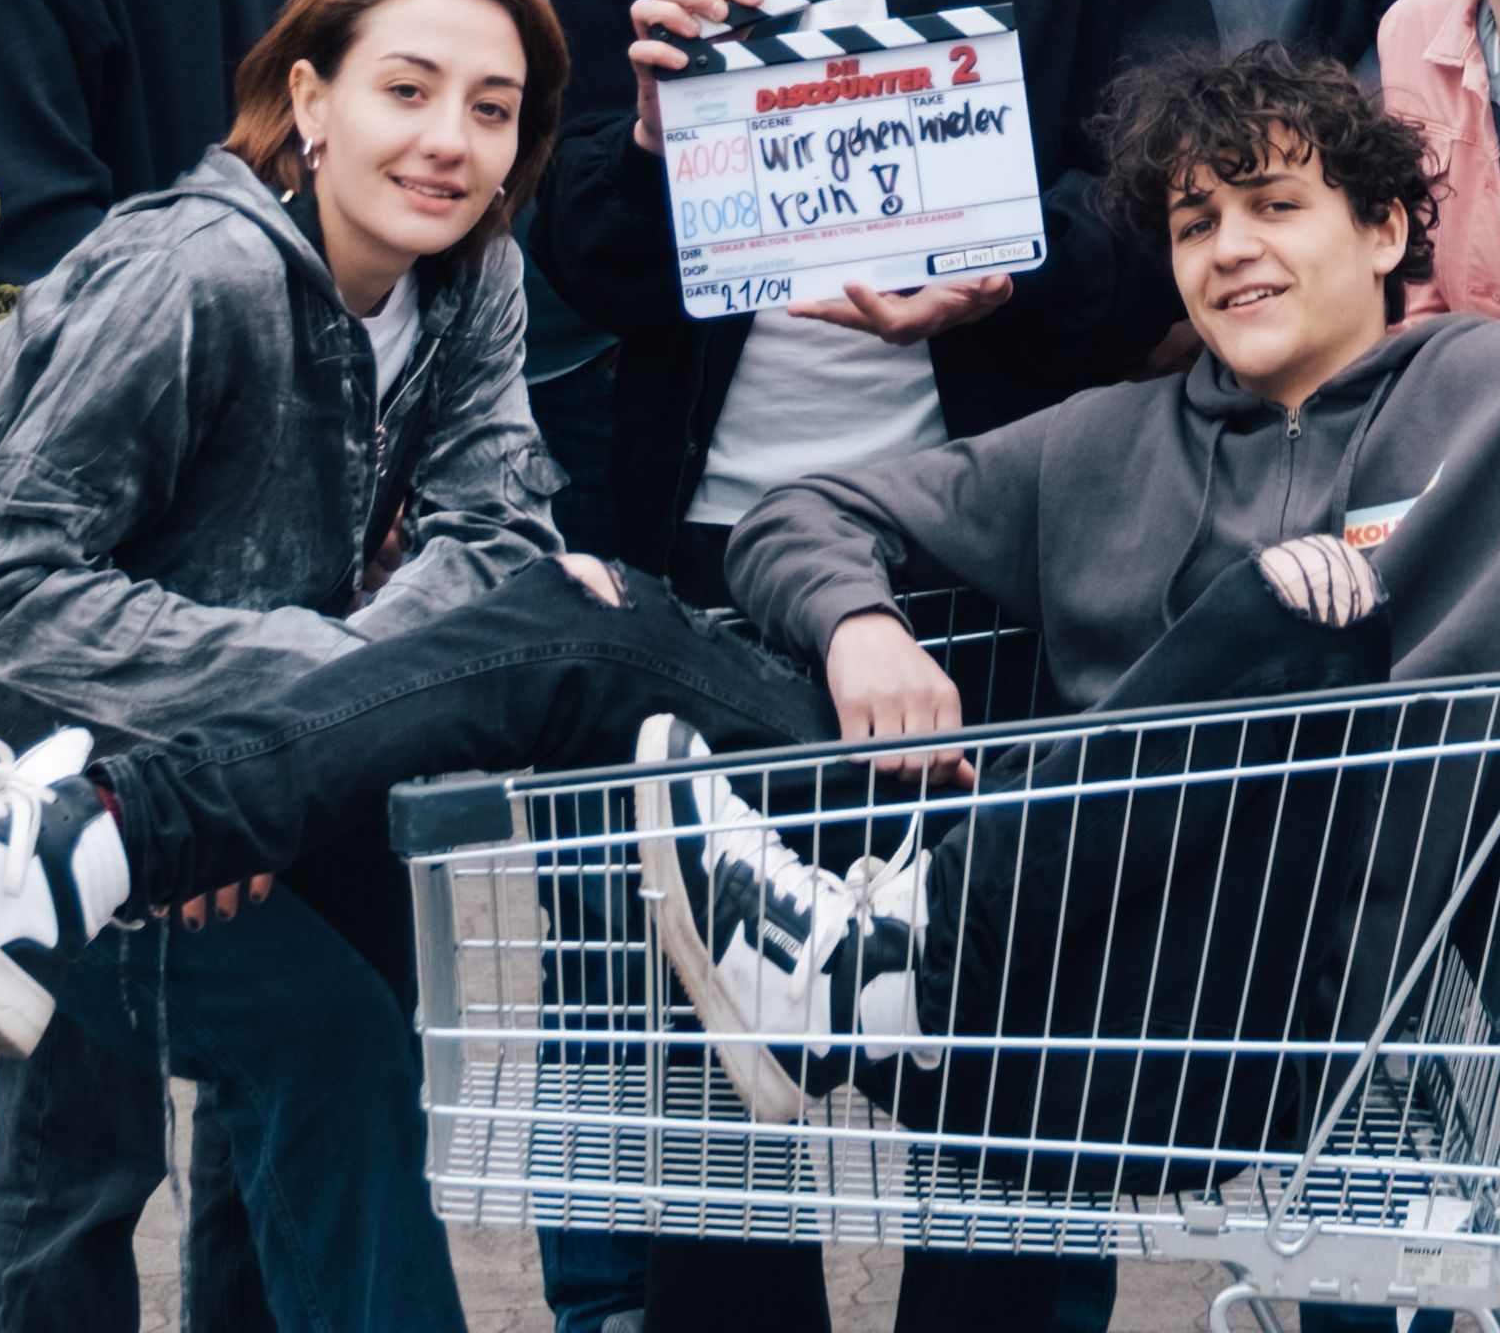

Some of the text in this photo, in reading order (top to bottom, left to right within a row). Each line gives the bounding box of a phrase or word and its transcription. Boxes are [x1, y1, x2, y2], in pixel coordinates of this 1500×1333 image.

[827, 59, 861, 79] DIE
[756, 44, 981, 113] DISCOUNTER 2
[913, 93, 945, 108] TAKE
[751, 116, 794, 131] SCENE
[666, 130, 700, 142] ROLL
[826, 117, 915, 182] gehen
[676, 136, 749, 183] A009
[940, 257, 962, 269] DAY
[971, 251, 988, 263] INT
[683, 264, 709, 277] DOP
[685, 283, 719, 298] DATE
